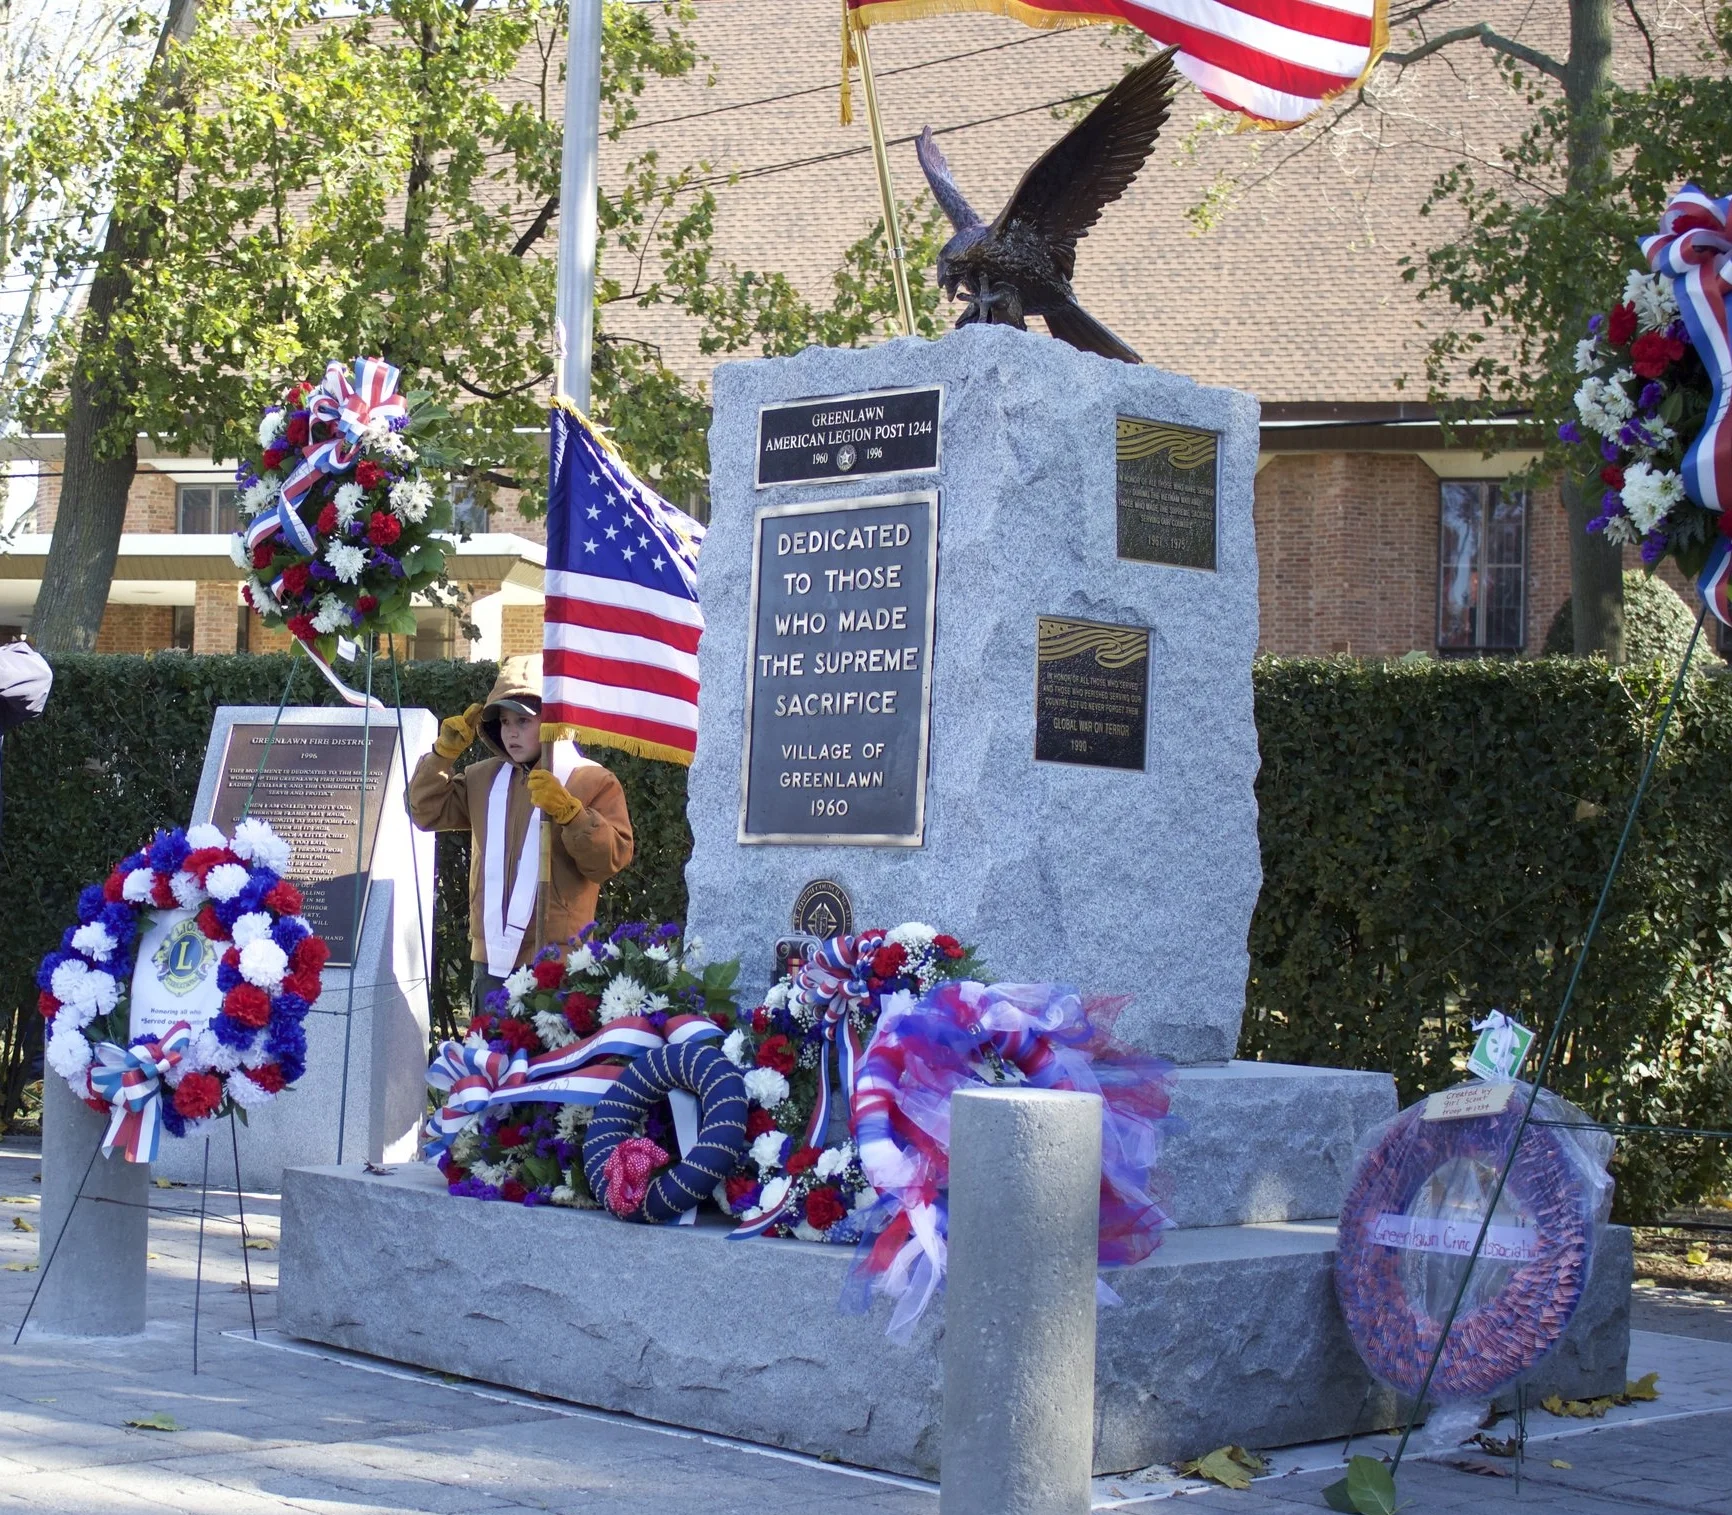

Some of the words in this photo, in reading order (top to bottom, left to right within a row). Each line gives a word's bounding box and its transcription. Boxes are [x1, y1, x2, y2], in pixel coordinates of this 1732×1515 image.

[812, 407, 884, 427] GREENLAWN
[766, 432, 825, 452] AMERICAN
[828, 427, 872, 446] LEGION
[875, 424, 904, 440] POST
[908, 421, 932, 436] 1244
[812, 452, 828, 464] 1960
[866, 448, 882, 460] 1996
[778, 524, 910, 556] DEDICATED
[784, 572, 811, 595] TO
[824, 565, 902, 592] THOSE
[775, 612, 826, 636] WHO
[838, 606, 907, 632] MADE
[759, 654, 804, 676] THE
[814, 647, 918, 674] SUPREME
[1081, 676, 1089, 685] ALL
[1090, 678, 1107, 687] THOSE
[1107, 680, 1119, 688] WHO
[1120, 681, 1138, 690] SERVED
[1084, 689, 1108, 699] PERISHED
[774, 691, 897, 716] SACRIFICE
[1088, 702, 1104, 711] NEVER
[1106, 704, 1124, 714] FORGET
[1053, 717, 1077, 731] GLOBAL
[1079, 720, 1092, 733] WAR
[1094, 722, 1103, 733] ON
[1105, 723, 1130, 737] TERROR
[782, 744, 852, 760] VILLAGE
[862, 743, 884, 758] OF
[1071, 740, 1087, 752] 1990
[780, 772, 883, 788] GREENLAWN
[811, 800, 848, 816] 1960
[176, 942, 192, 970] L
[150, 1007, 178, 1015] Honoring
[1446, 1088, 1478, 1100] Created
[1374, 1216, 1438, 1247] Greenlawn
[1443, 1226, 1471, 1252] Civic
